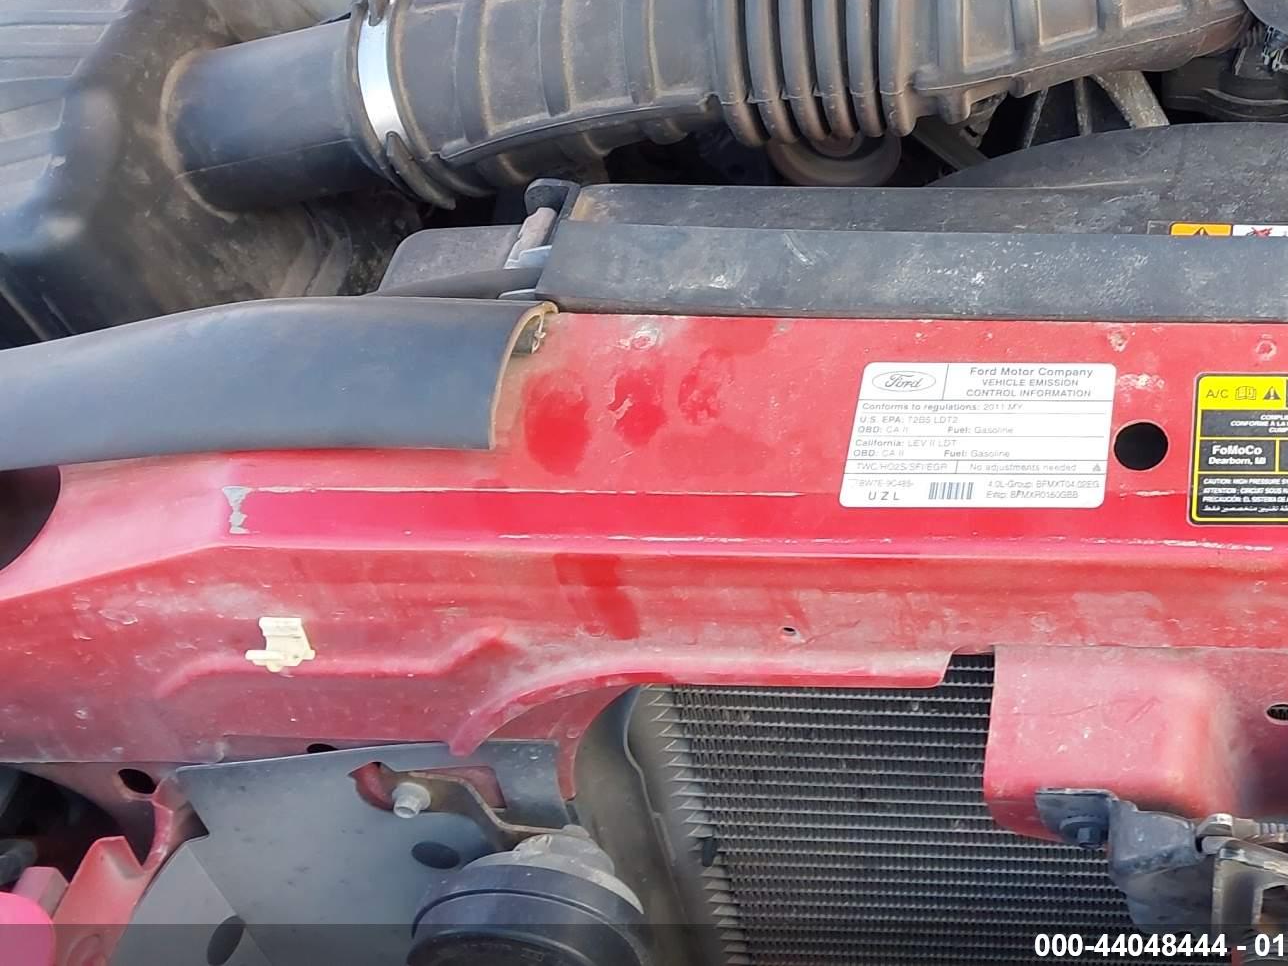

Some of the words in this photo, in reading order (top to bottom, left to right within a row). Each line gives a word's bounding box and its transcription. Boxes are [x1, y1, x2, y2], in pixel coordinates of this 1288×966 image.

[970, 366, 997, 376] Ford
[1000, 366, 1034, 376] Motor
[1038, 367, 1093, 379] Company
[885, 374, 924, 388] Ford
[982, 378, 1027, 387] VEHICLE
[1029, 379, 1079, 387] EMISSION
[966, 389, 1017, 397] CONTROL
[1019, 389, 1092, 397] INFORMATION
[1206, 388, 1229, 399] A/C
[862, 402, 909, 411] Conforms
[911, 403, 921, 411] to
[923, 403, 980, 412] regulations:
[881, 416, 905, 424] EPA:
[857, 425, 882, 434] OBD:
[947, 426, 972, 434] Fuel:
[855, 439, 905, 447] California:
[944, 450, 968, 458] Fuel:
[970, 450, 1011, 458] Gasoline
[1212, 444, 1263, 455] FoMoCo
[1208, 457, 1253, 465] Dearborn,
[969, 463, 983, 472] No
[1042, 463, 1077, 472] needed
